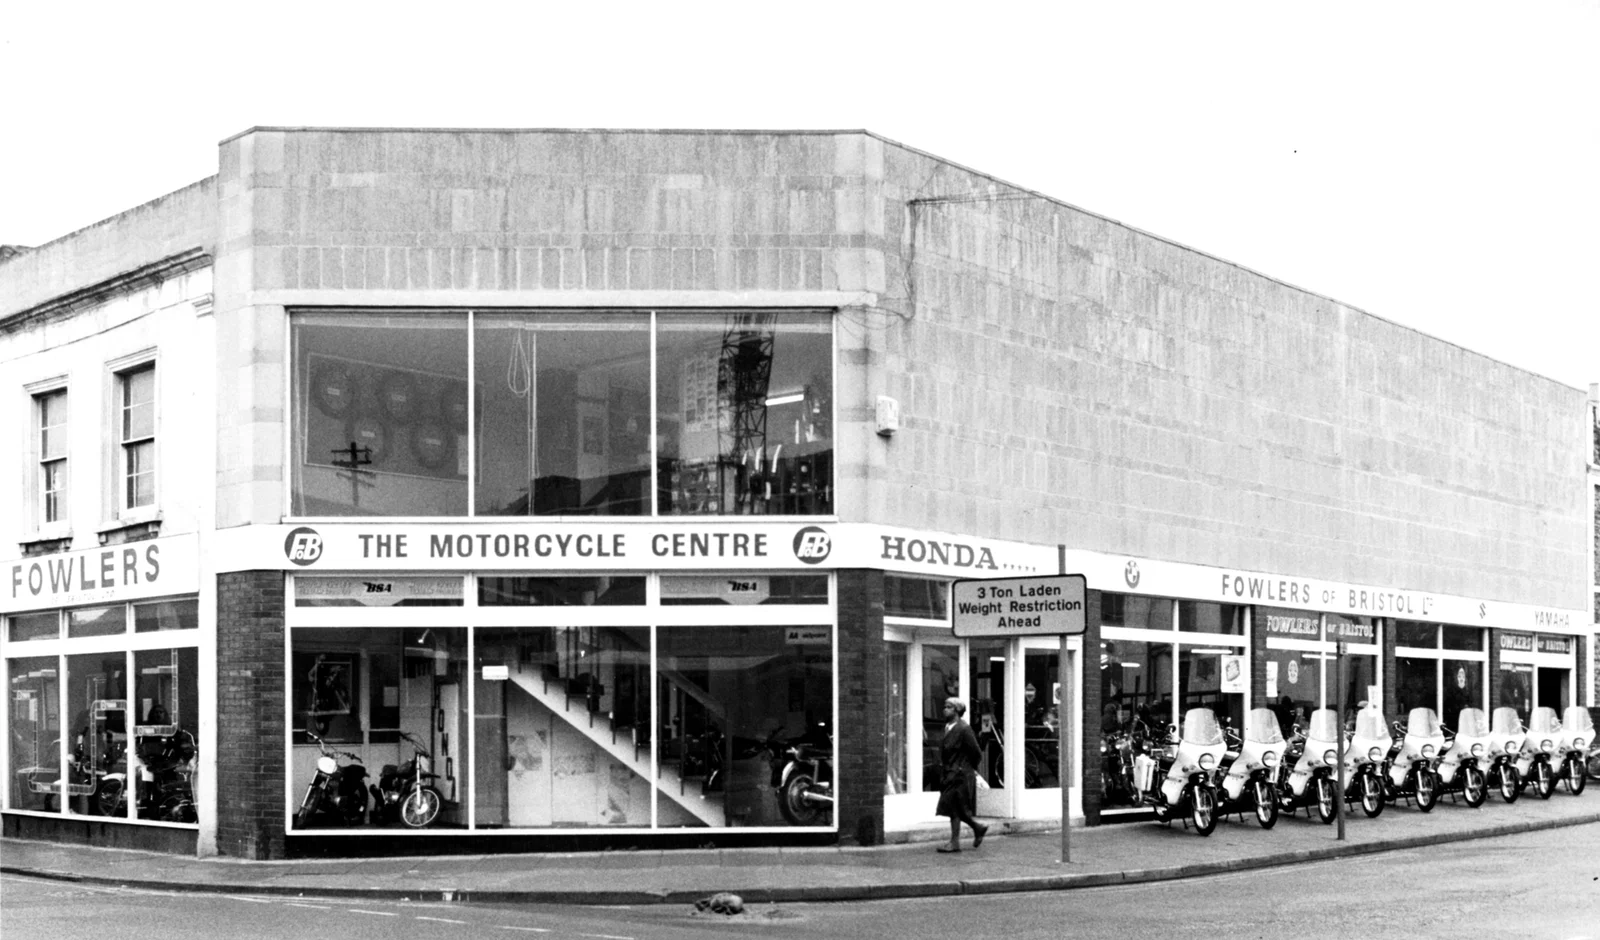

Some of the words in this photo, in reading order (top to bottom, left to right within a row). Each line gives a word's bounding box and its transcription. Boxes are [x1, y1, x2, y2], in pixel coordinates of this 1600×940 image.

[358, 534, 408, 558] THE
[430, 534, 626, 558] MOTORCYCLE
[651, 533, 768, 557] CENTRE
[12, 544, 160, 598] FOWLERS
[363, 581, 392, 593] BSA
[728, 580, 757, 592] BSA
[977, 587, 986, 599] 3
[990, 586, 1013, 598] Ton
[1020, 585, 1061, 597] Laden
[1222, 574, 1310, 604] FOWLERS
[1322, 590, 1336, 604] OF
[1349, 589, 1413, 614] BRISTOL
[959, 602, 1002, 616] Weight
[1010, 599, 1081, 612] Restriction
[998, 615, 1041, 628] Ahead
[1266, 615, 1319, 634] FOWLERS
[1339, 623, 1374, 637] BRISTOL
[1535, 610, 1570, 628] YAMAHA
[1500, 635, 1532, 650] OWLERS
